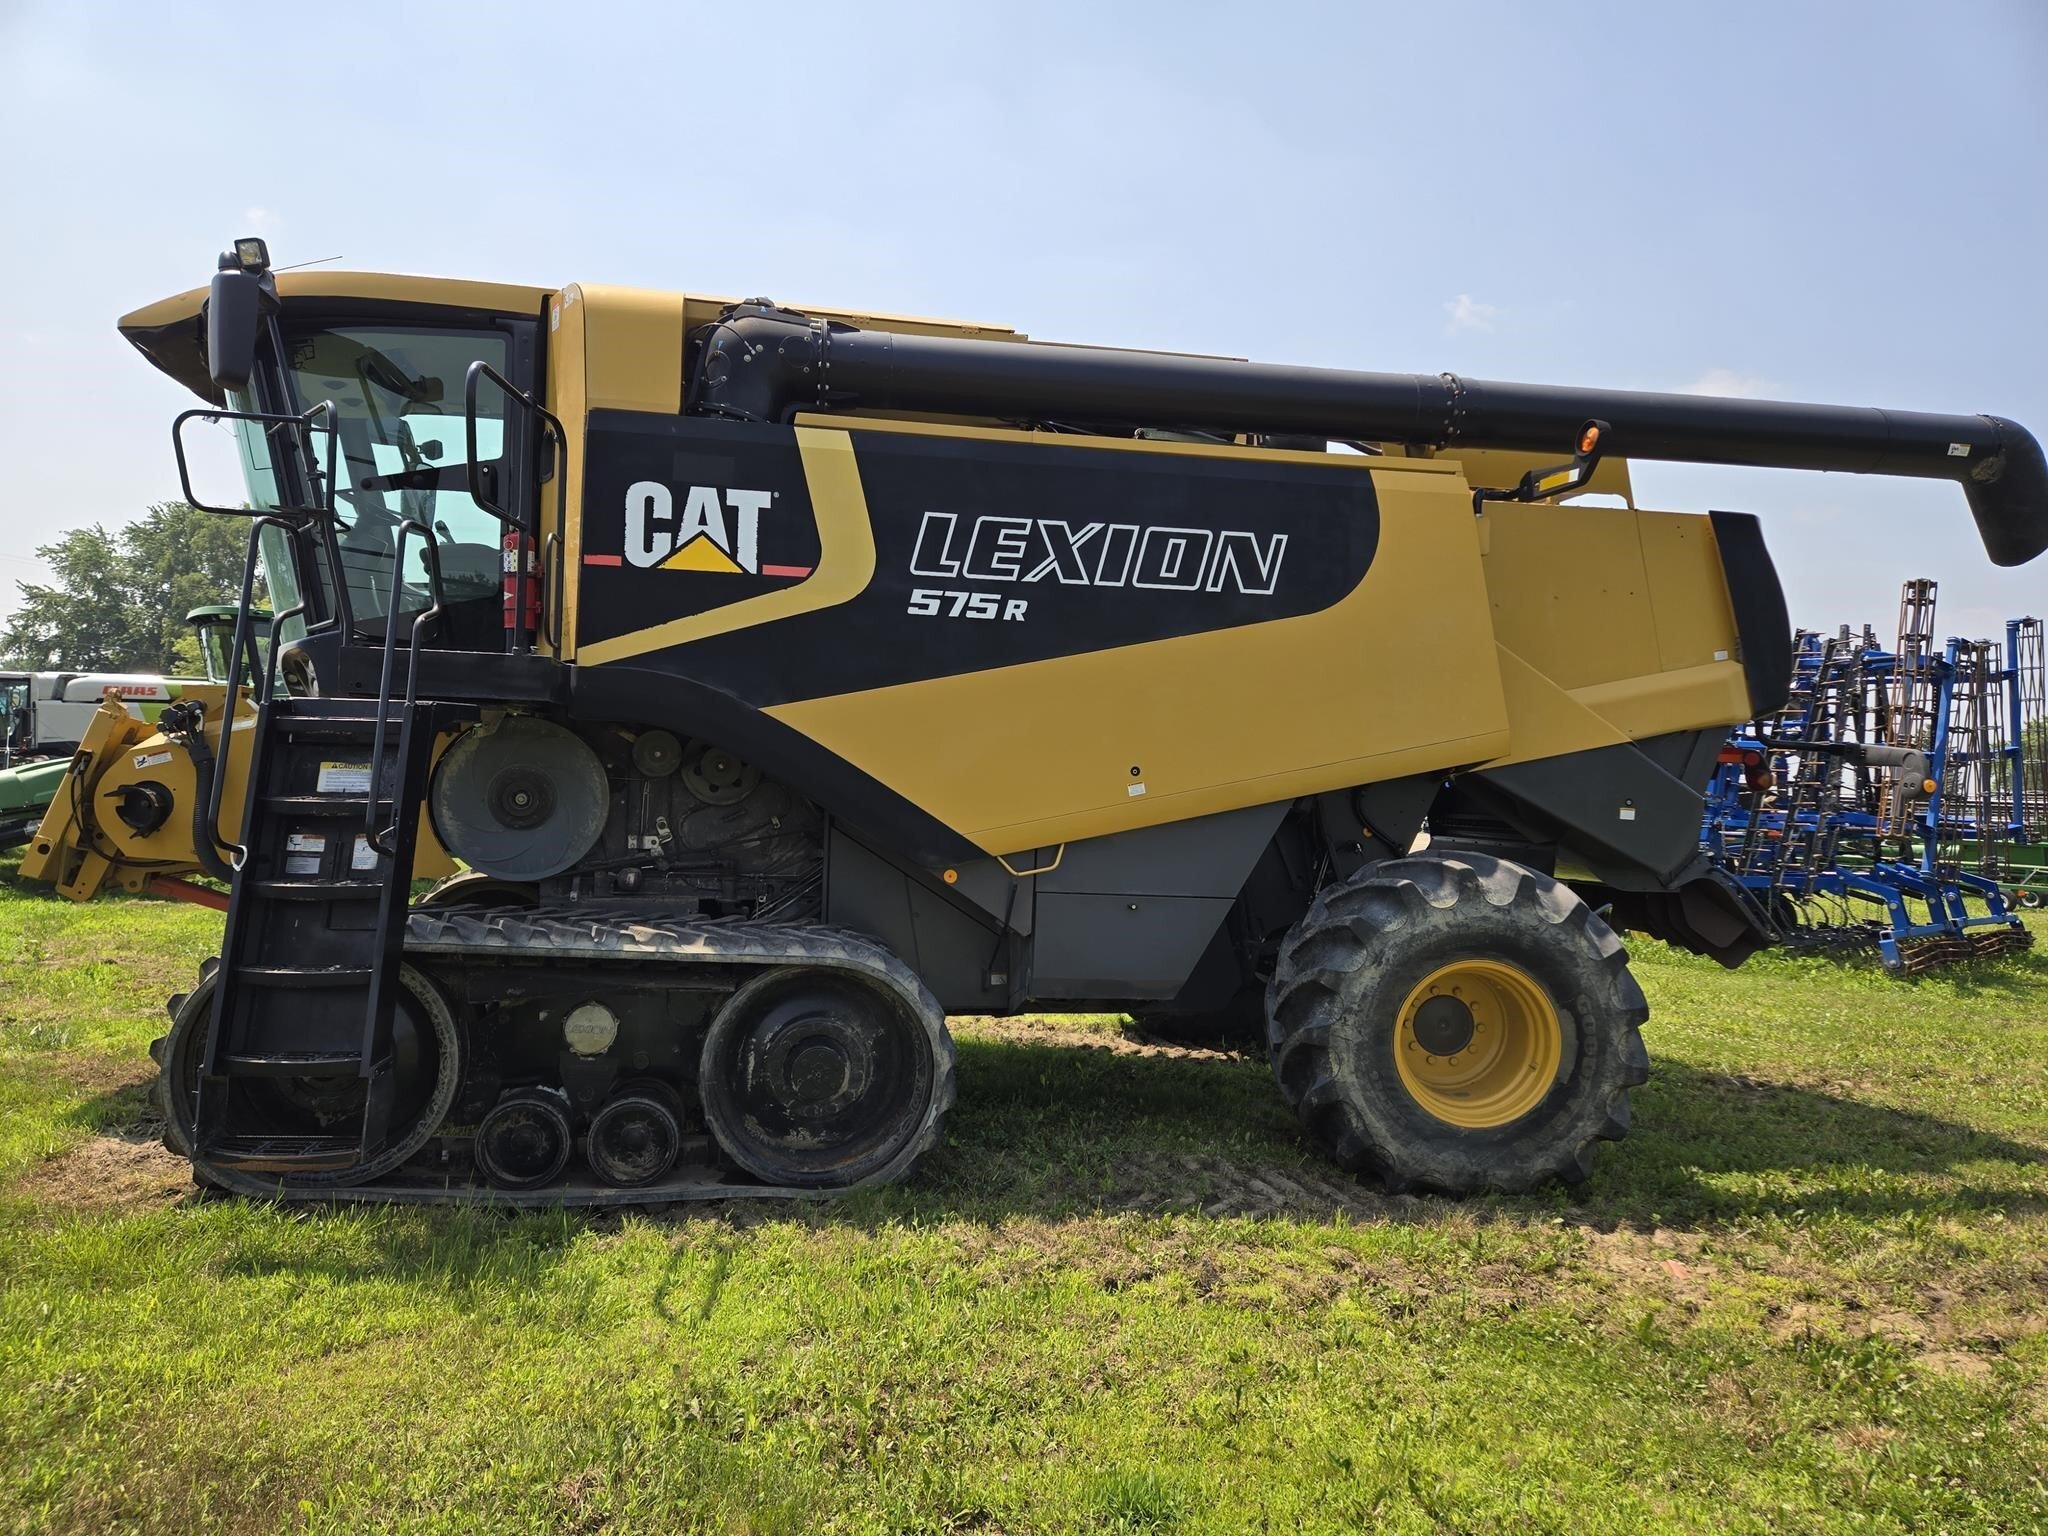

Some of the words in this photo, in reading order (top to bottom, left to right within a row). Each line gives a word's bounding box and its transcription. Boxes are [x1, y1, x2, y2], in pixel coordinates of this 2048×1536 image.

[624, 481, 771, 574] CAT
[910, 511, 1288, 595] LEXION
[102, 685, 158, 696] CAAS
